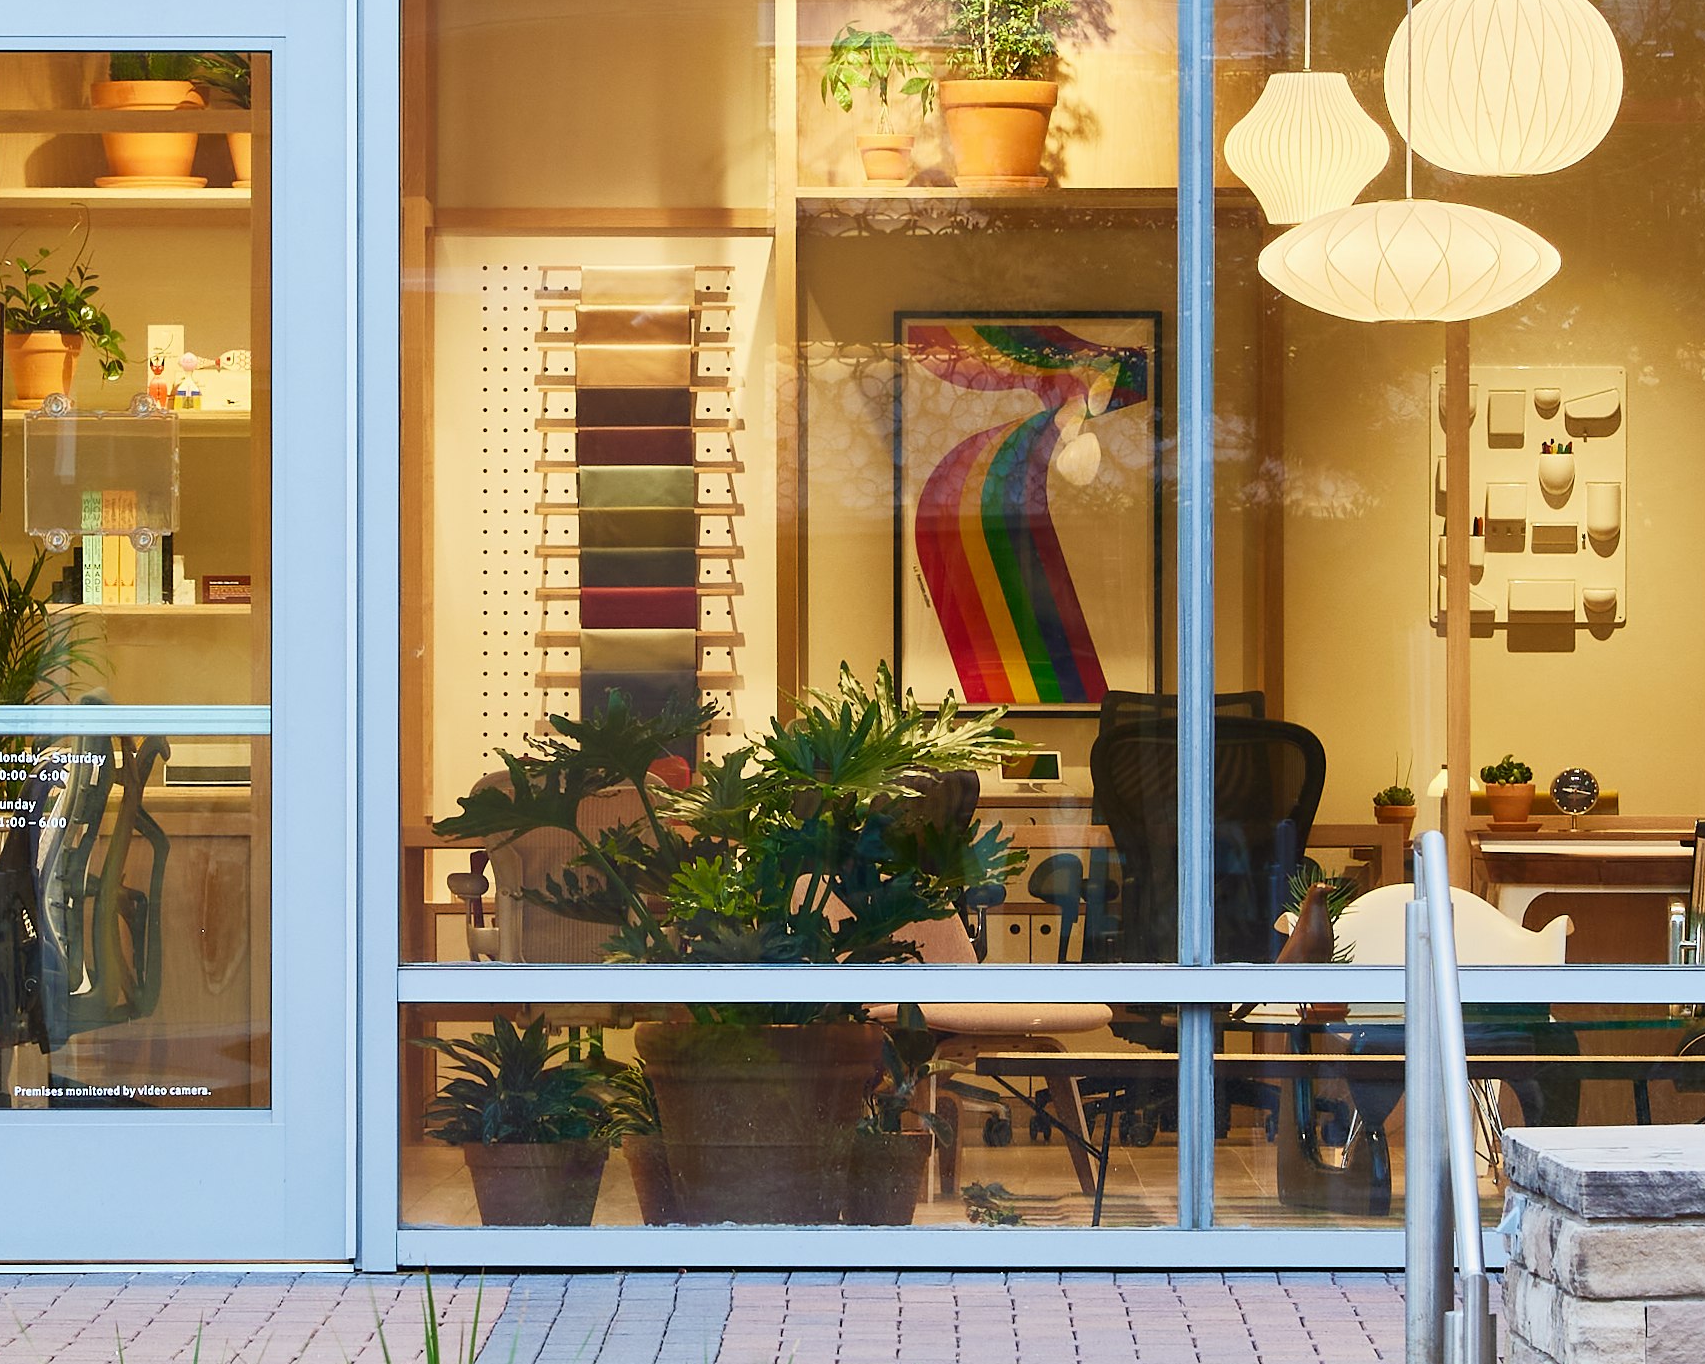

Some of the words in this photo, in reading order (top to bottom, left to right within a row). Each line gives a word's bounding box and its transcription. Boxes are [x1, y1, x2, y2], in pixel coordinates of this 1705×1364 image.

[51, 752, 107, 767] Saturday
[39, 769, 69, 781] 6:00
[14, 1085, 64, 1097] Premises
[65, 1085, 121, 1096] monitored
[122, 1085, 137, 1099] by
[138, 1085, 168, 1096] video
[169, 1085, 212, 1096] camera.
